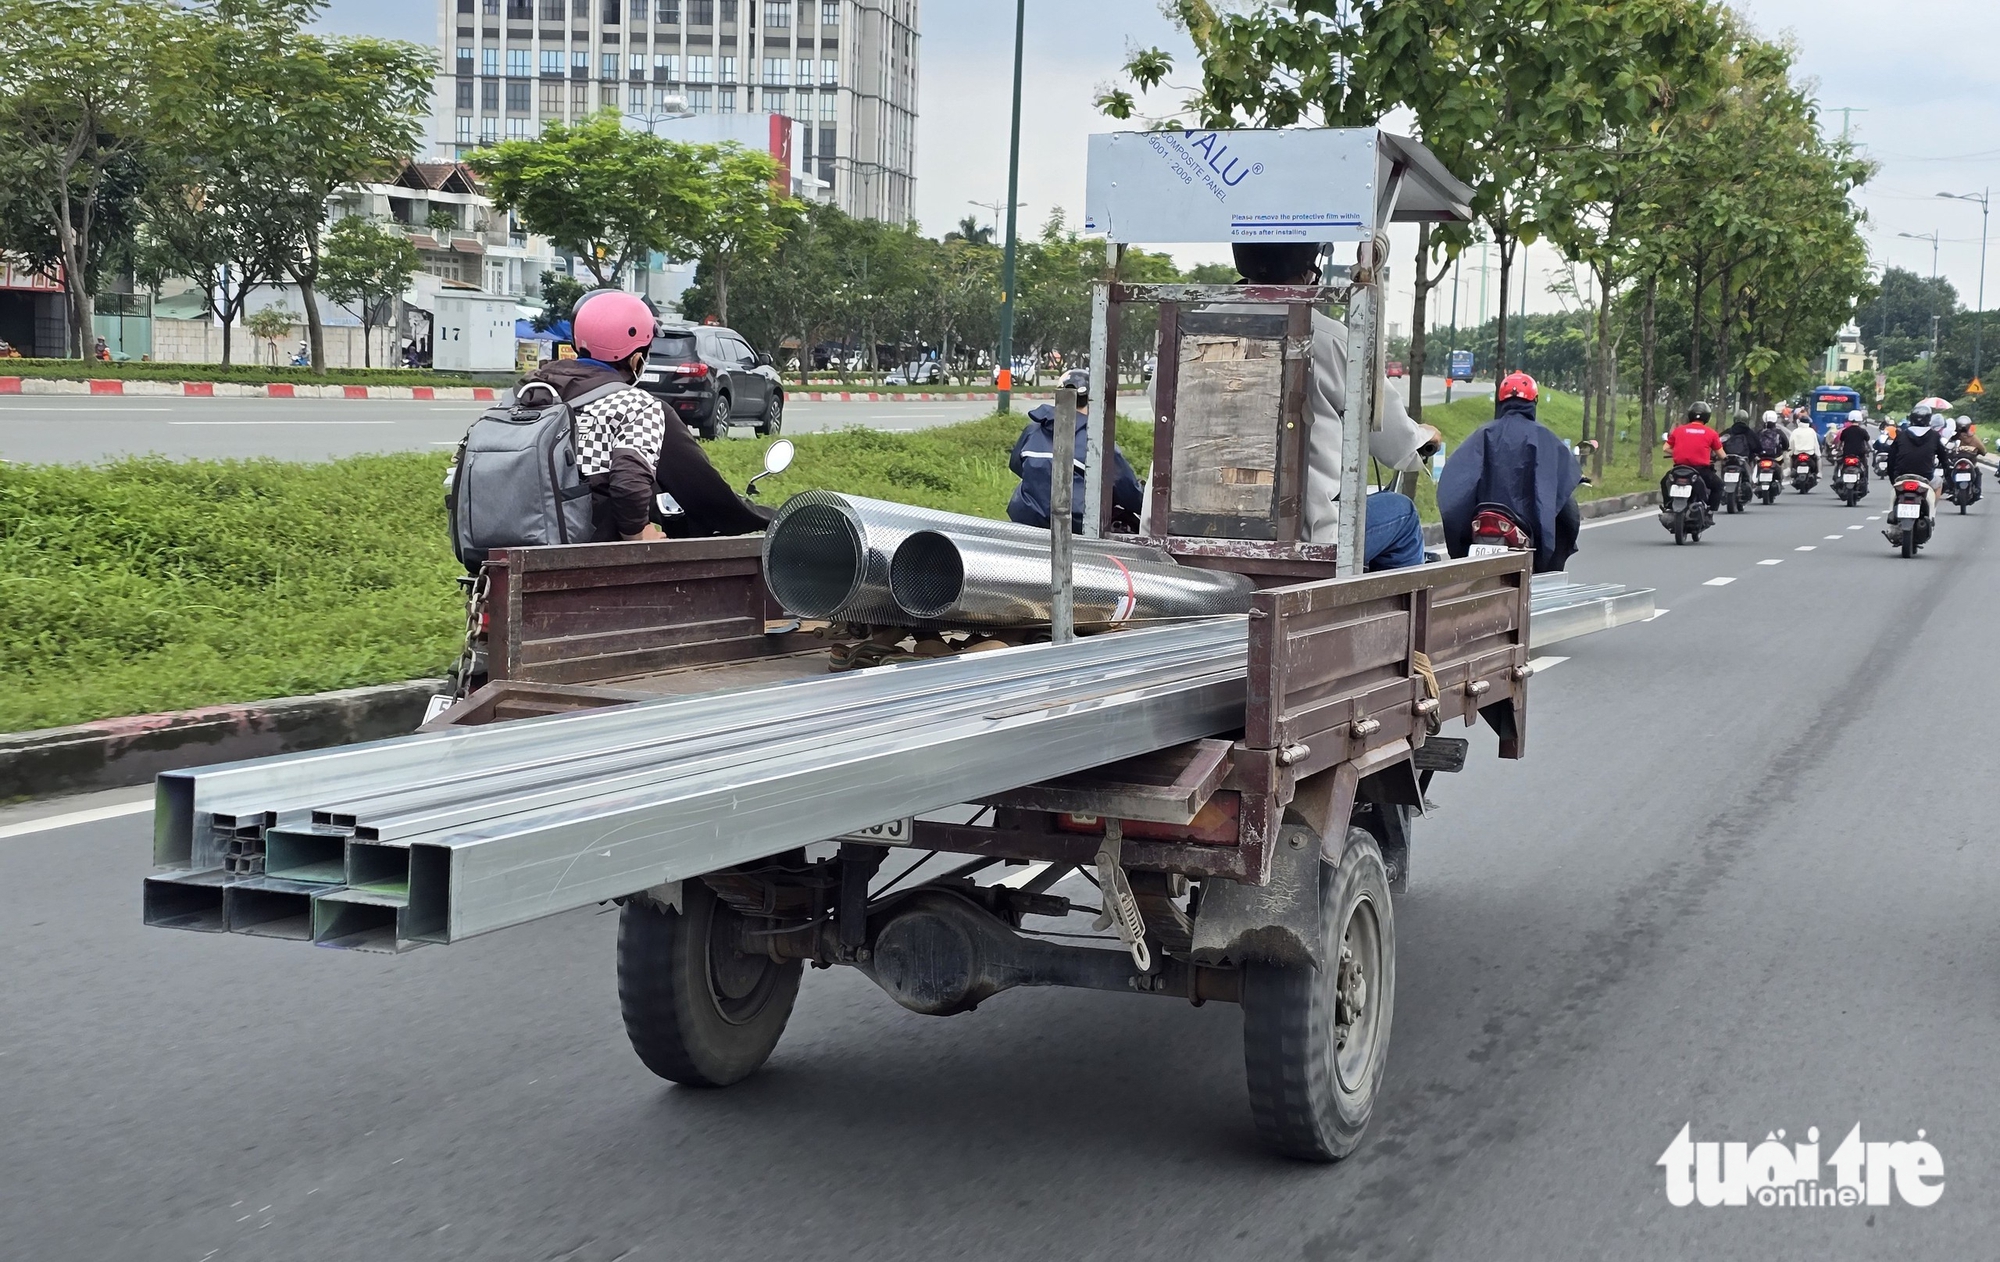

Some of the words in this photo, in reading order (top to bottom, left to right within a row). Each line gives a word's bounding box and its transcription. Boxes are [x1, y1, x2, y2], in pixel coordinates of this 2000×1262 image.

[1149, 137, 1169, 158] 9001
[1171, 162, 1193, 185] 2008
[1161, 131, 1204, 177] COMPOSITE
[1202, 176, 1228, 203] PANEL
[1241, 229, 1257, 237] days
[1275, 229, 1307, 237] installing
